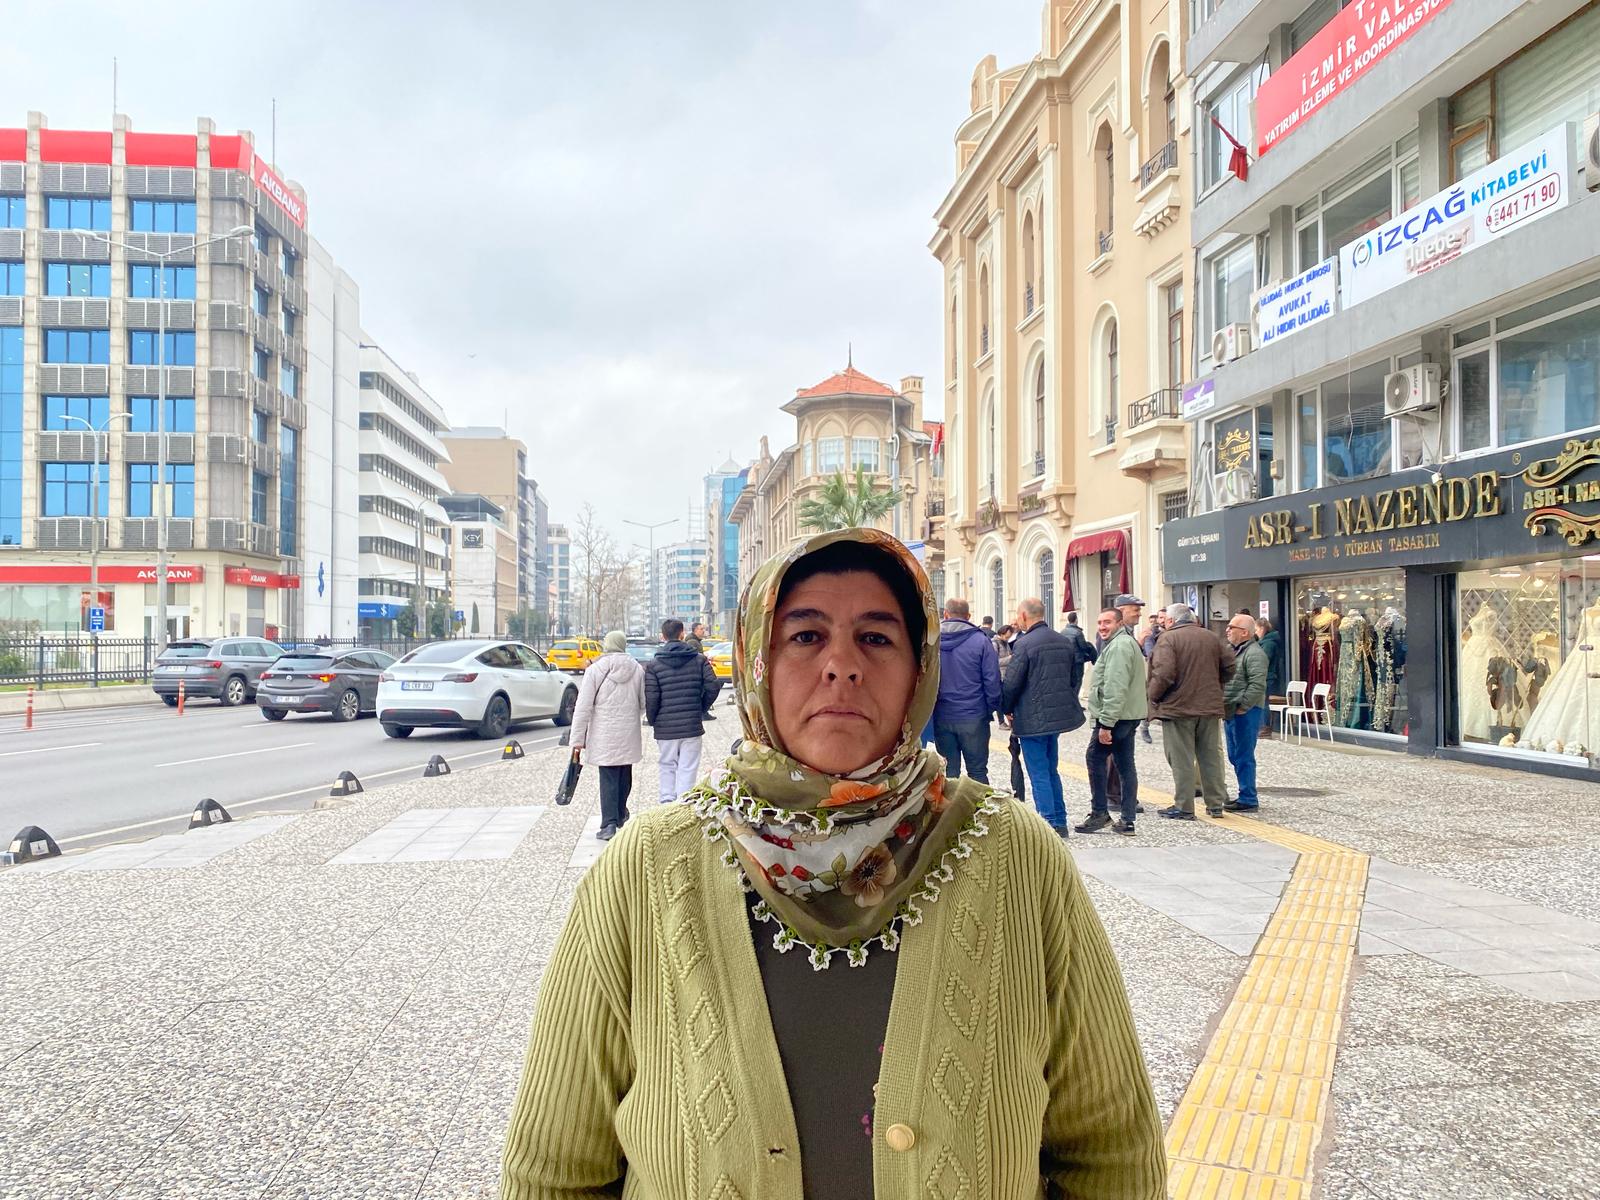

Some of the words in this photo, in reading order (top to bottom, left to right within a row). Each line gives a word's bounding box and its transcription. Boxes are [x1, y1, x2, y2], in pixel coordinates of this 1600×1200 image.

[1302, 35, 1357, 95] İZMİR
[1364, 0, 1415, 39] VAL
[1264, 108, 1300, 145] YATIRIM
[1301, 80, 1336, 116] İZLEME
[1338, 64, 1353, 84] VE
[1354, 0, 1444, 72] KOORDİNASYO
[260, 171, 301, 221] AKBANK
[1377, 186, 1467, 256] İZÇAĞ
[1471, 148, 1548, 207] KİTABEVİ
[1500, 200, 1519, 221] 441
[1524, 190, 1536, 211] 71
[1541, 181, 1555, 202] 90
[1263, 325, 1275, 343] ALİ
[1298, 299, 1330, 326] ULUDAĞ
[1278, 291, 1312, 318] AVUKAT
[1244, 503, 1325, 549] ASR-I
[1334, 470, 1502, 537] NAZENDE
[1522, 484, 1571, 511] ASR-I
[464, 534, 481, 542] KEY
[1289, 545, 1327, 562] MAKE-UP
[1333, 545, 1340, 558] &
[1345, 539, 1383, 557] TÜRBAN
[1389, 533, 1440, 552] TASARIM
